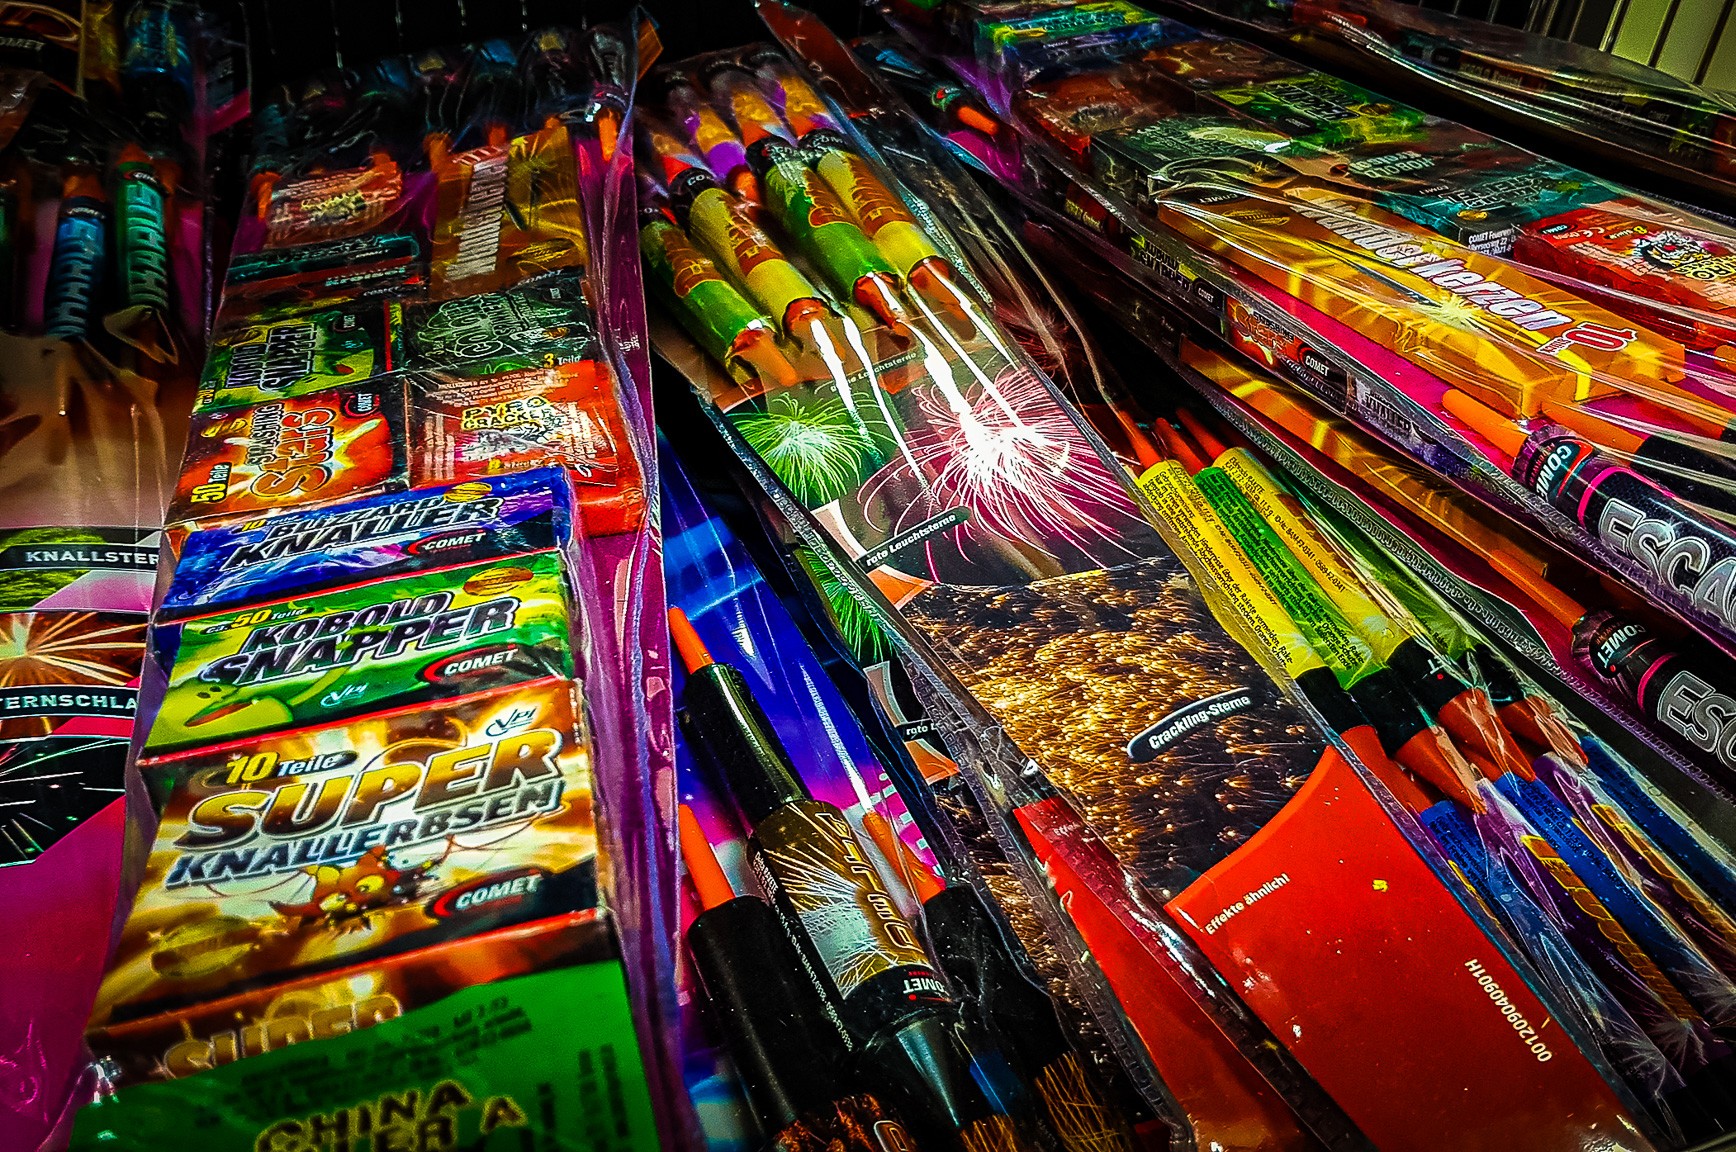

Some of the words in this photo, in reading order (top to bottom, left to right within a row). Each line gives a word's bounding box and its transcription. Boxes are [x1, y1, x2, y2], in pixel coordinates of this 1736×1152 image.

[542, 352, 555, 368] 3
[1302, 354, 1331, 377] COMET
[206, 463, 231, 484] Teile
[1534, 443, 1573, 501] COME
[424, 532, 488, 556] COMET
[889, 512, 959, 556] Leuchtsterne
[231, 606, 270, 627] 50
[240, 591, 456, 656] KOBOLD
[200, 597, 523, 688] SNAPPER
[443, 648, 520, 678] COMET
[1597, 622, 1647, 667] COMET
[0, 693, 137, 710] ERNSCHLA
[1147, 693, 1252, 751] Crackling-Sterne
[223, 752, 276, 783] 10
[277, 752, 343, 777] Teile
[173, 728, 566, 852] SUPER
[163, 781, 567, 889] KNALLERBSEN
[454, 871, 545, 911] COMET
[1205, 899, 1247, 936] Effekte
[1243, 872, 1291, 907] ähnlich!
[1464, 955, 1552, 1063] 001209040901H
